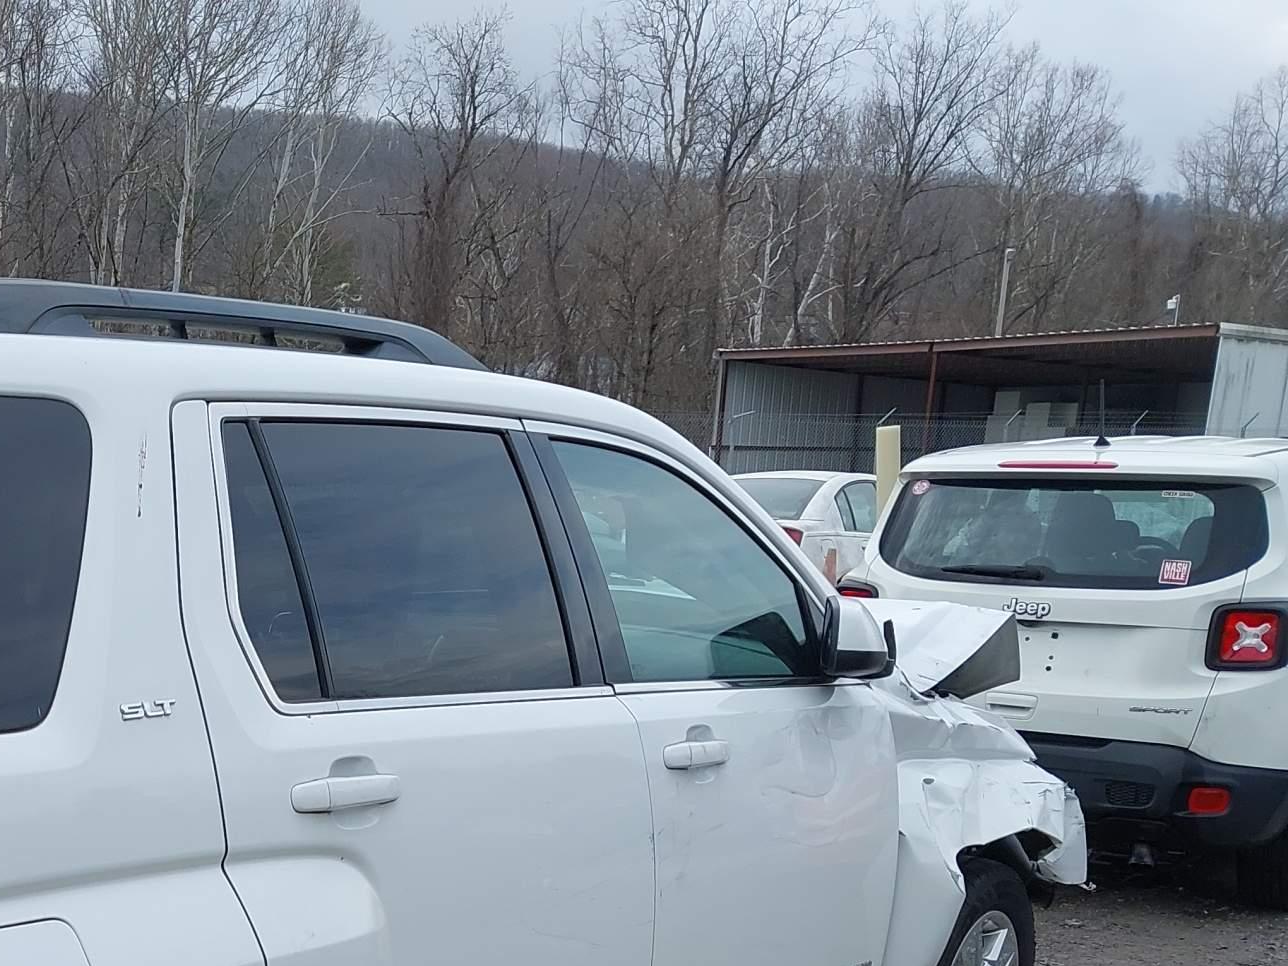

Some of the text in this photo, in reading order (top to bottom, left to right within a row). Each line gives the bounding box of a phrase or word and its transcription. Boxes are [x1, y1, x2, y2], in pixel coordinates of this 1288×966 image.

[1164, 561, 1189, 574] NASH
[1163, 570, 1186, 581] VILLE
[1003, 597, 1051, 619] Jeep
[119, 698, 176, 722] SLT
[1128, 704, 1193, 715] SPORT
